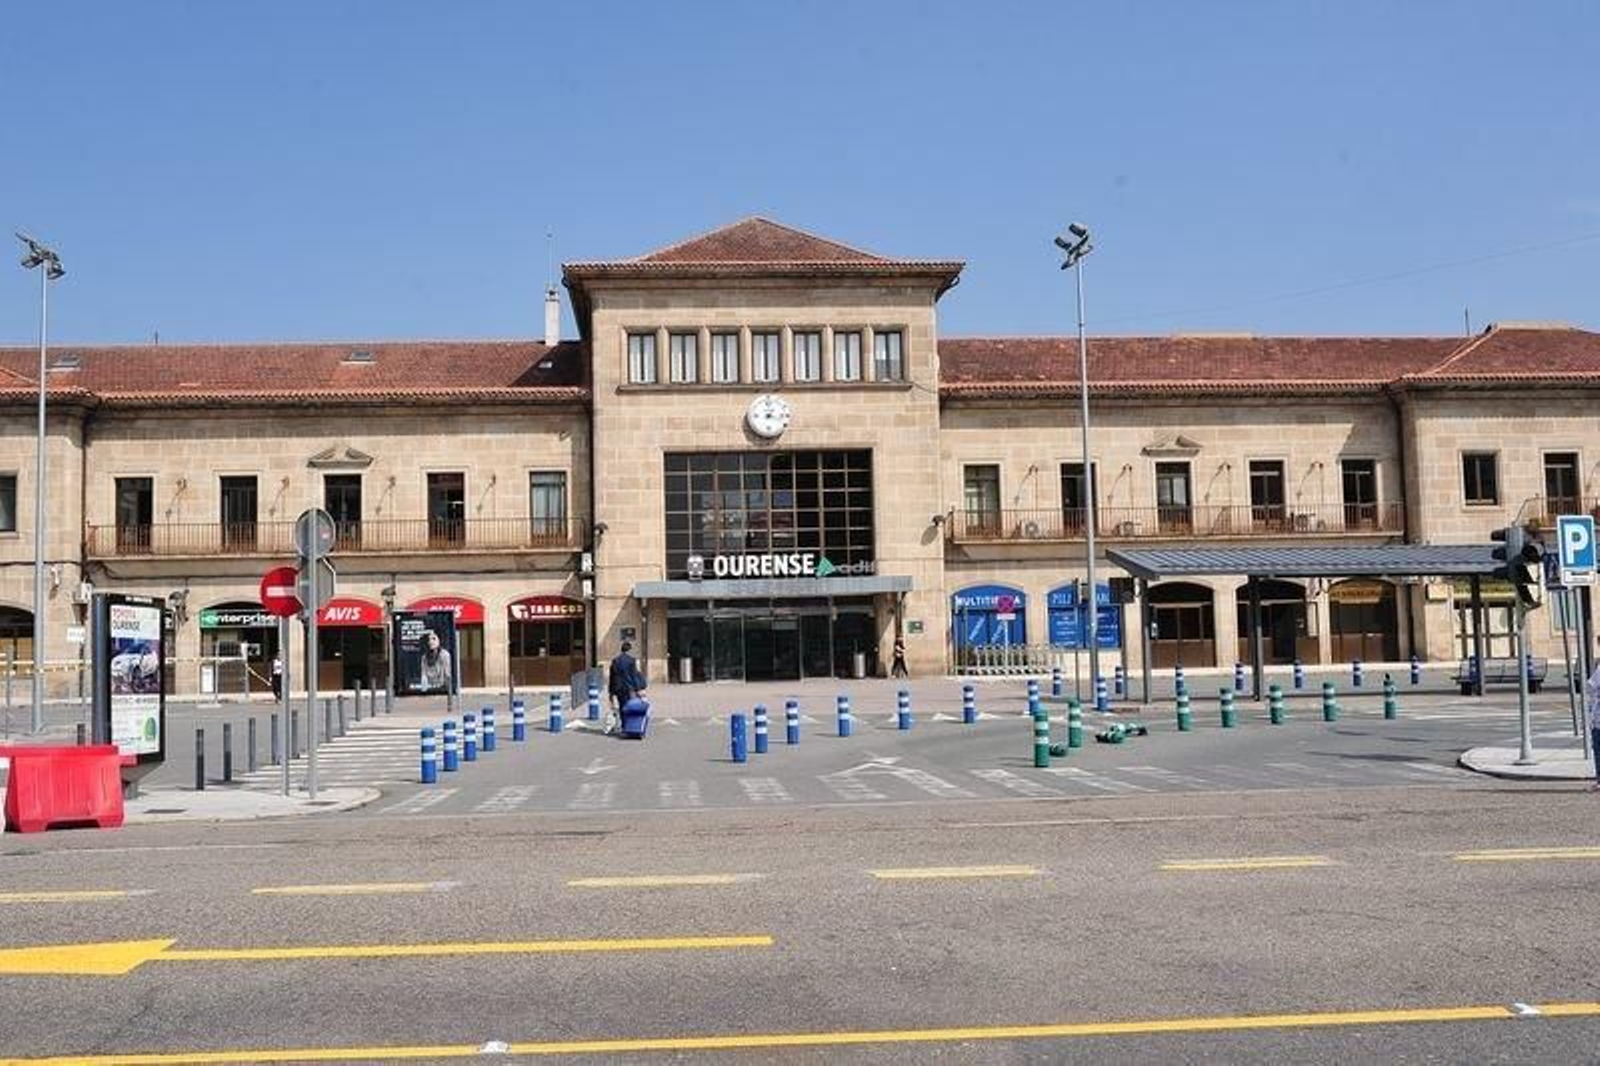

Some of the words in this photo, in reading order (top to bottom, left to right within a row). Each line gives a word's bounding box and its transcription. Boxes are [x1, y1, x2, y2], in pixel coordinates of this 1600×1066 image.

[1564, 523, 1589, 564] P
[713, 554, 815, 576] OURENSE
[325, 607, 361, 620] AVIS
[530, 605, 584, 614] TABACOS
